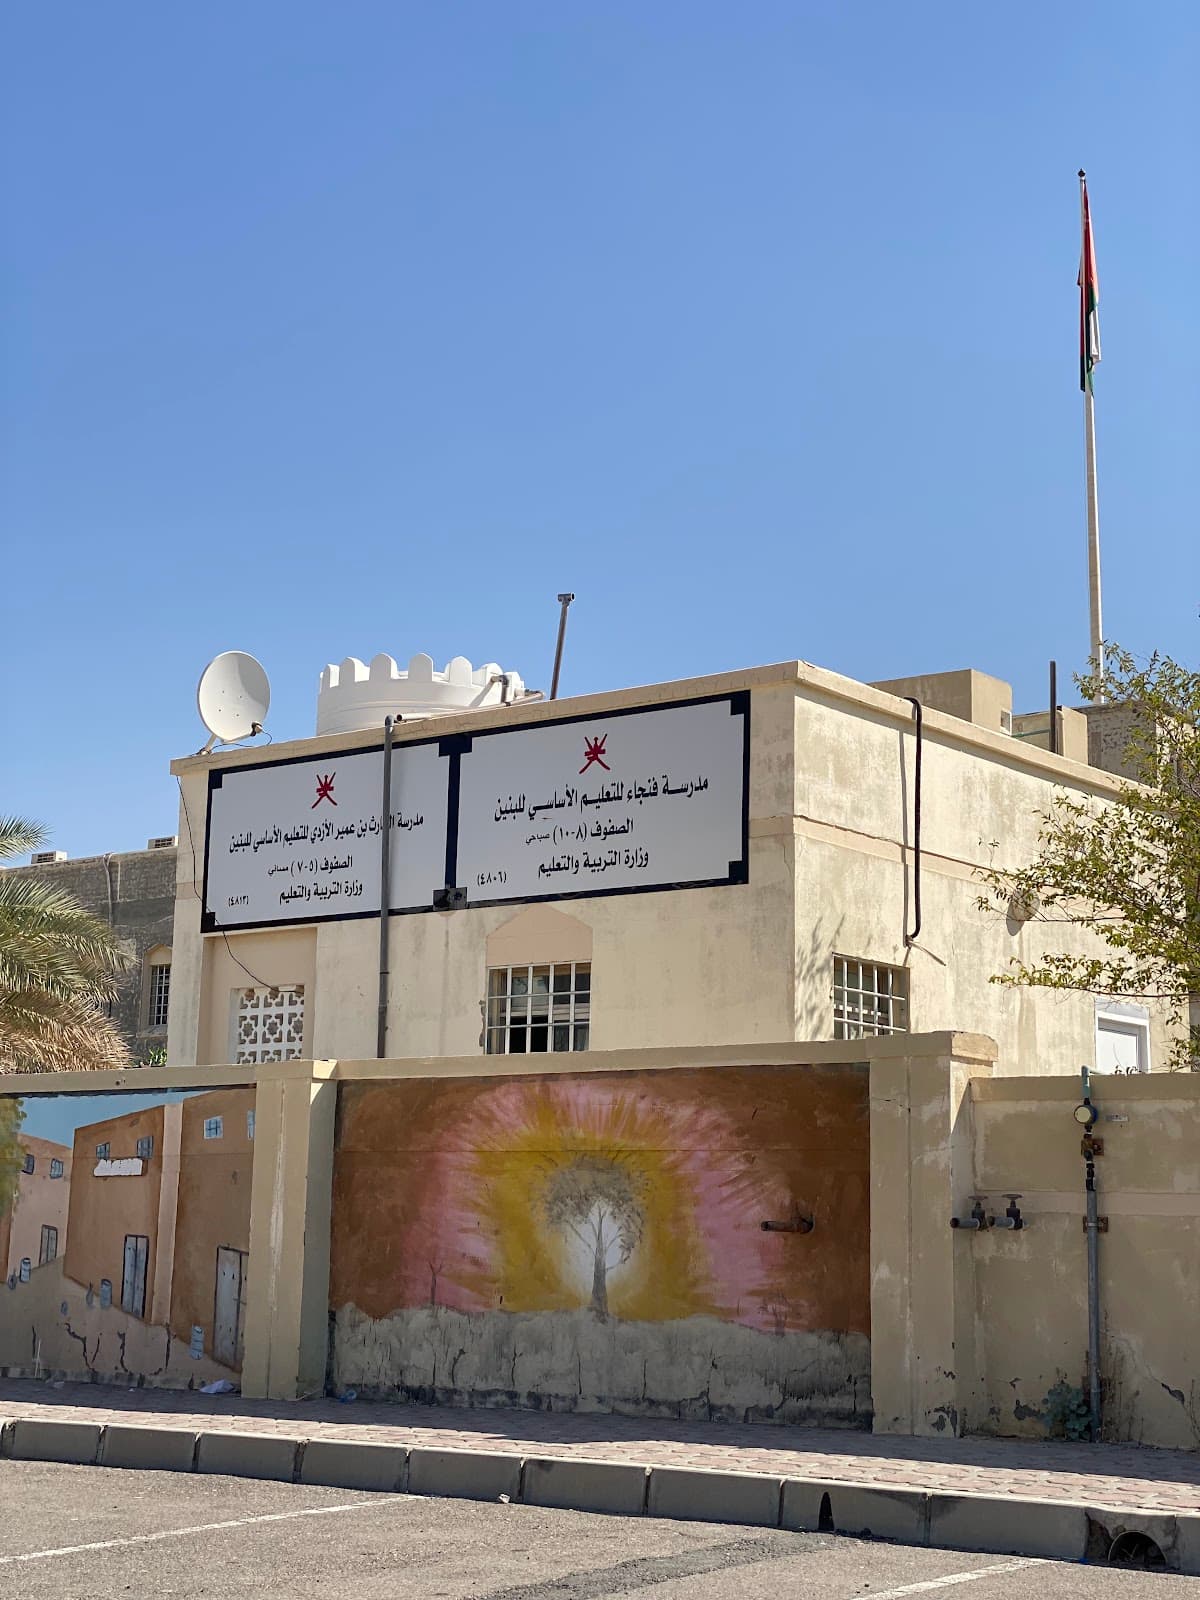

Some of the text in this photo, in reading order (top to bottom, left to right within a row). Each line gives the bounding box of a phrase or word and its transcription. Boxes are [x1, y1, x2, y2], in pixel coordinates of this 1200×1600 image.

[495, 774, 708, 821] مدرسة فنجاء للتعليم الأساسي للبنين
[230, 812, 423, 852] مدرسة الارث بن عمير الأزدي للتعليم الأساسي للبنين
[526, 833, 550, 845] صباحي
[591, 818, 633, 840] الصفوف
[320, 854, 352, 873] الصفوف
[539, 847, 648, 879] وزارة التربية والتعليم
[280, 880, 362, 904] وزارة التربية والتعليم
